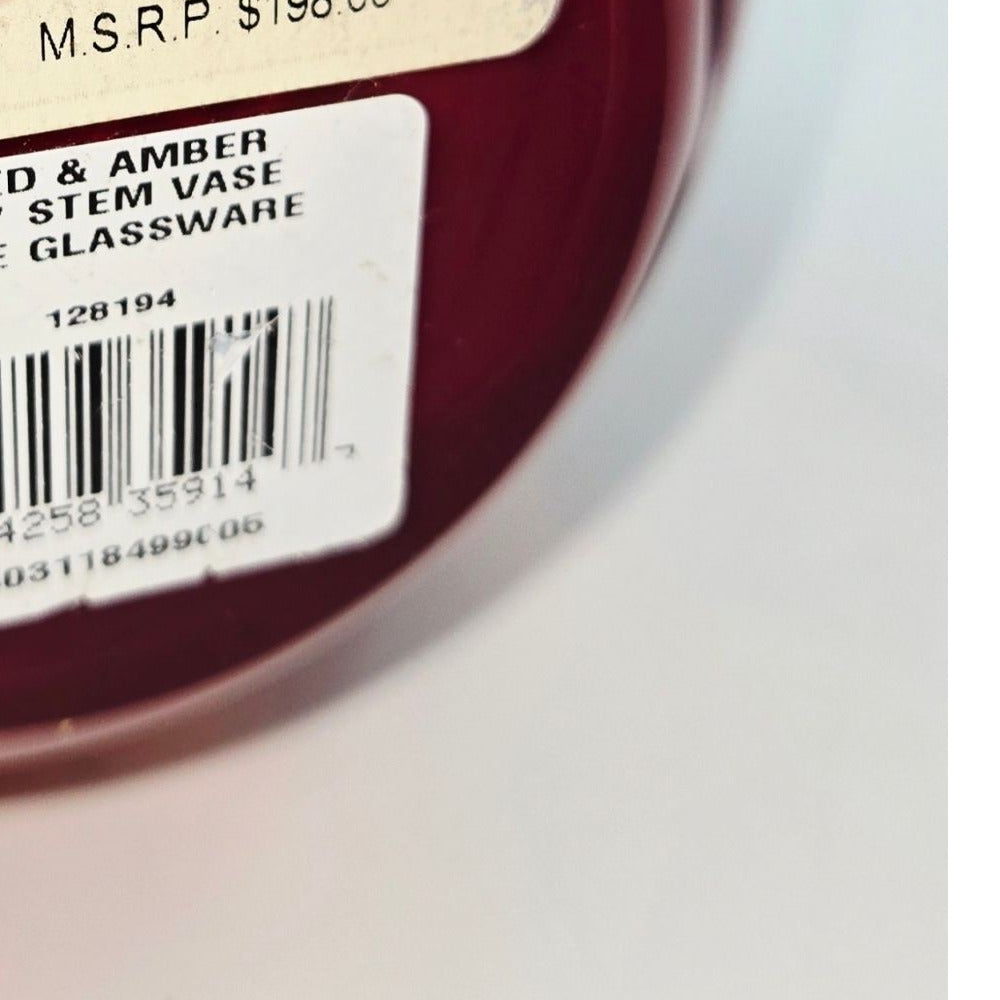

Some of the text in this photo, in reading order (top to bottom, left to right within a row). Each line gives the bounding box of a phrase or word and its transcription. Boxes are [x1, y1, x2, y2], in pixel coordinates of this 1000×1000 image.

[56, 158, 88, 186] &
[109, 128, 268, 178] AMBER
[28, 181, 153, 226] STEM
[171, 159, 284, 201] VASE
[29, 191, 305, 263] GLASSWARE
[45, 287, 177, 329] 128194
[127, 468, 257, 518] 35914
